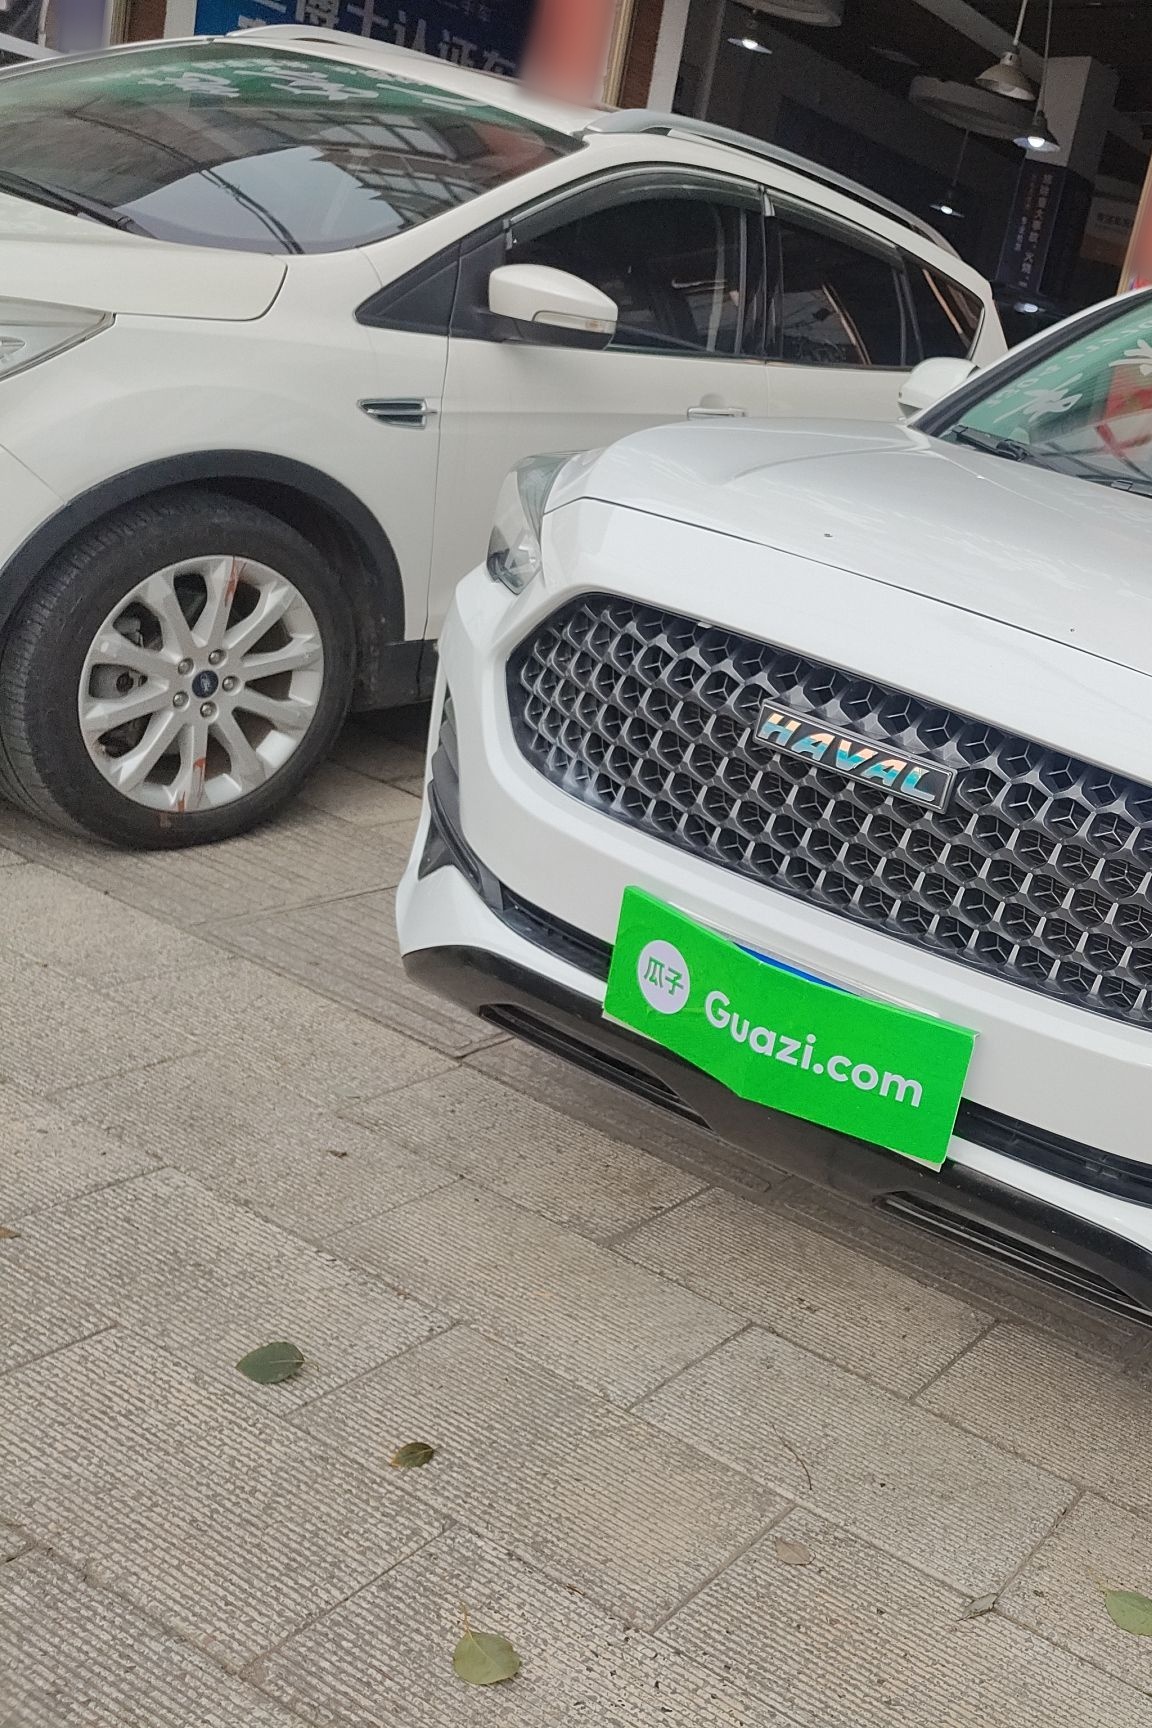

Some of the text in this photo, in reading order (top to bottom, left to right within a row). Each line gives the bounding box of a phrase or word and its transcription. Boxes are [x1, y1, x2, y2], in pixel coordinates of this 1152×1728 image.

[758, 712, 936, 802] HAVAL
[643, 956, 685, 996] 瓜子
[704, 990, 923, 1108] Guazi.com
